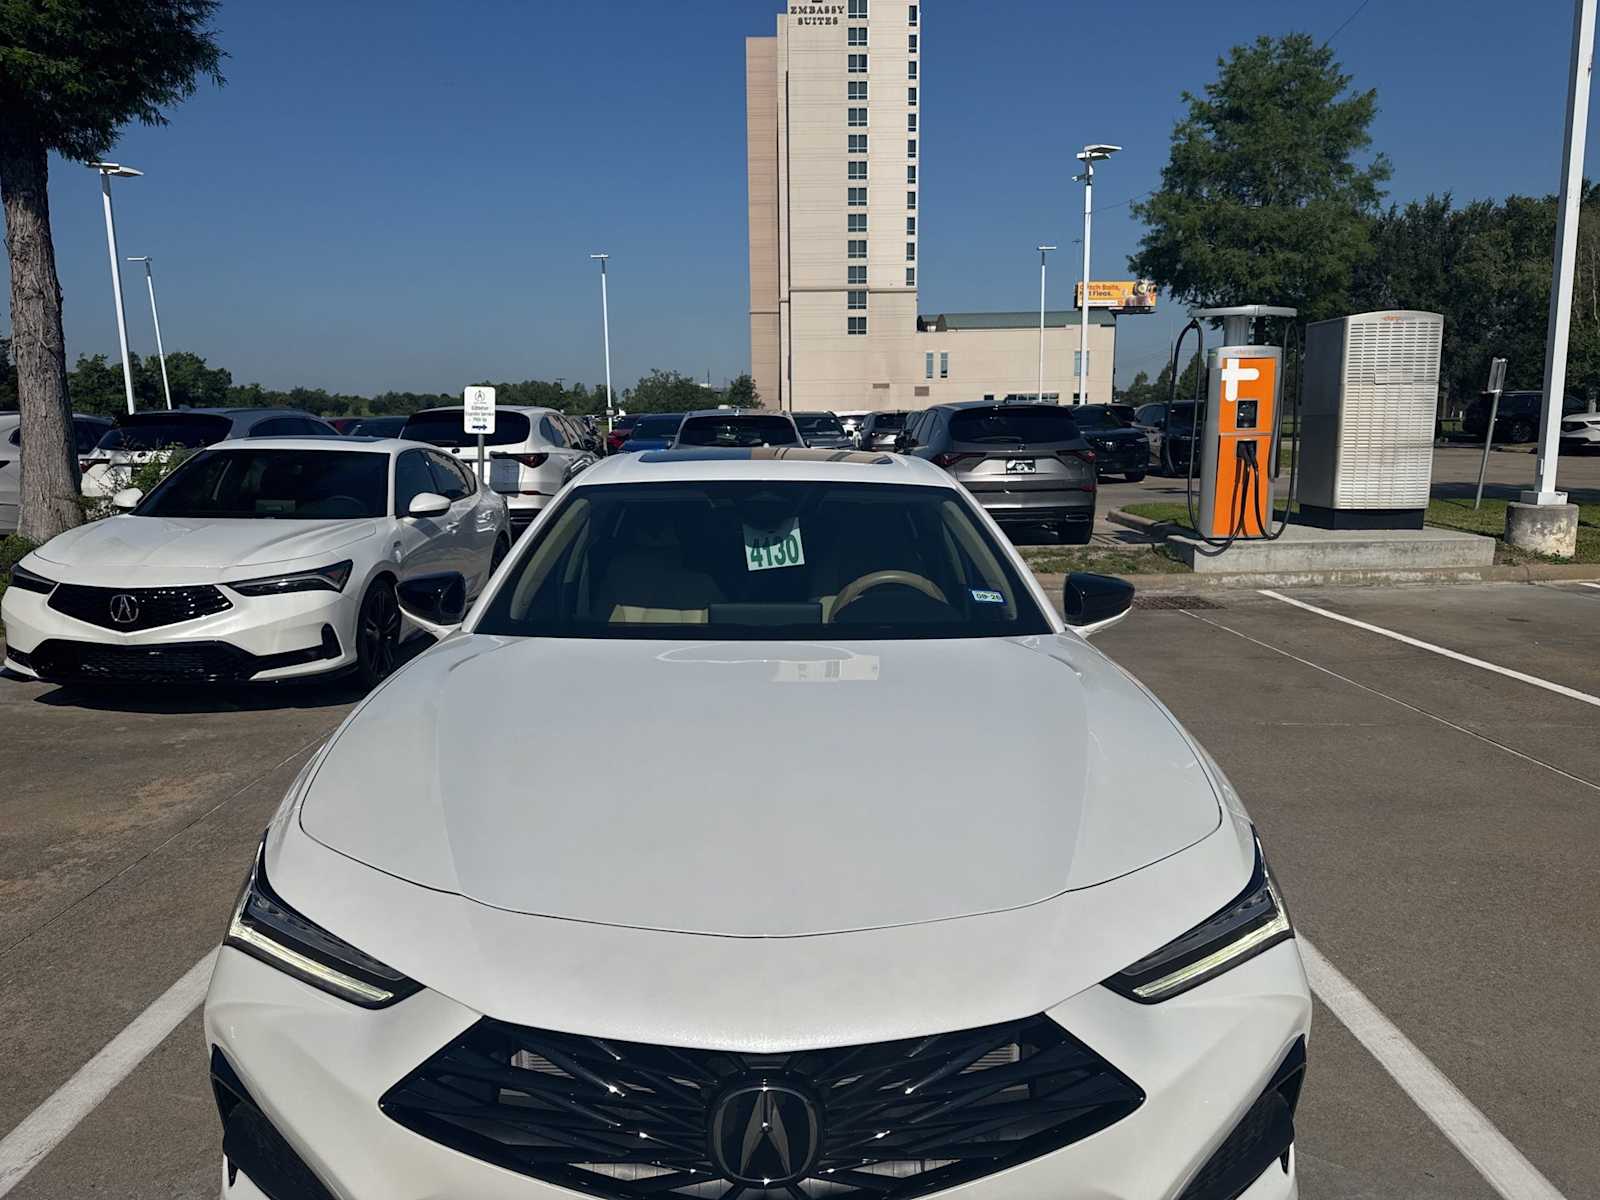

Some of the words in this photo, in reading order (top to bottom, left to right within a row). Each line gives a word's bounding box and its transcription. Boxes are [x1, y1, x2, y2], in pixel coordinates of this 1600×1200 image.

[790, 5, 845, 14] EMBASSY
[797, 16, 838, 25] SUITES
[750, 534, 799, 567] 4130
